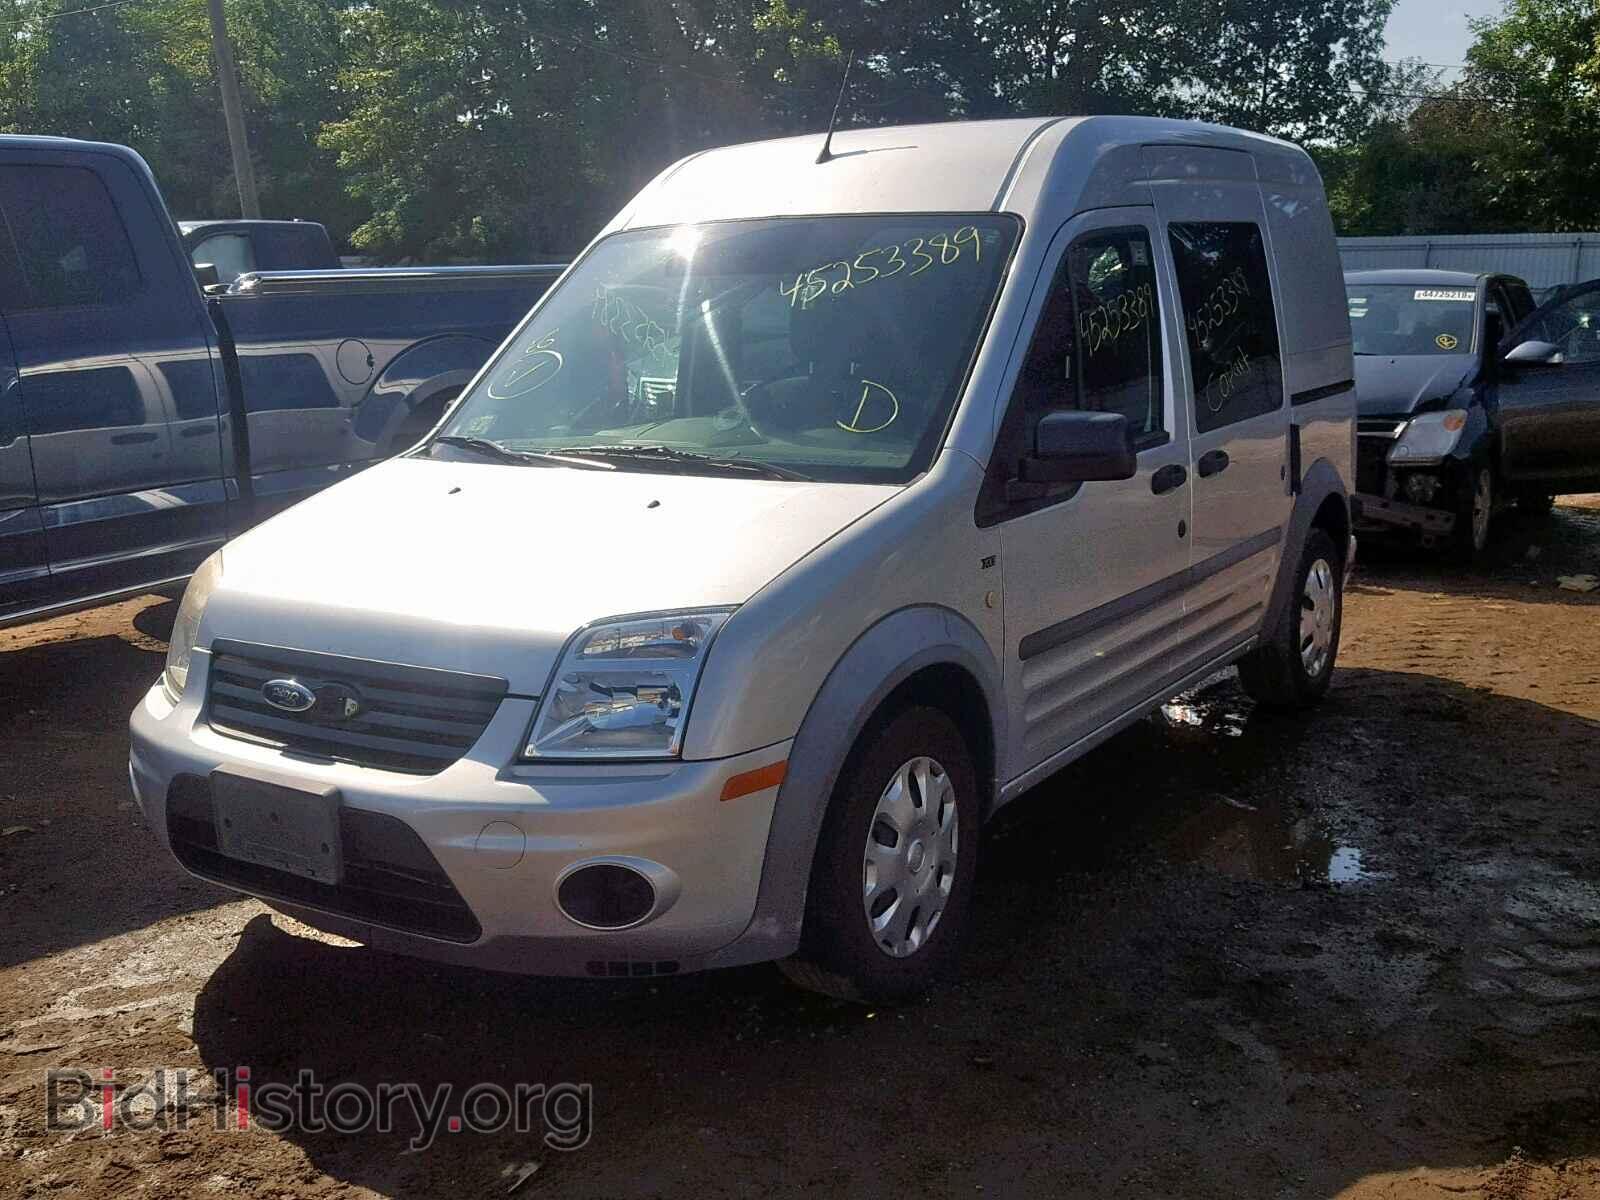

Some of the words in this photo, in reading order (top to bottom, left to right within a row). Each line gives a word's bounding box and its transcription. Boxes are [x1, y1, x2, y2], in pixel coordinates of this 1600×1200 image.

[780, 225, 980, 308] 45253389
[1079, 283, 1153, 357] 45253389
[836, 379, 899, 433] D
